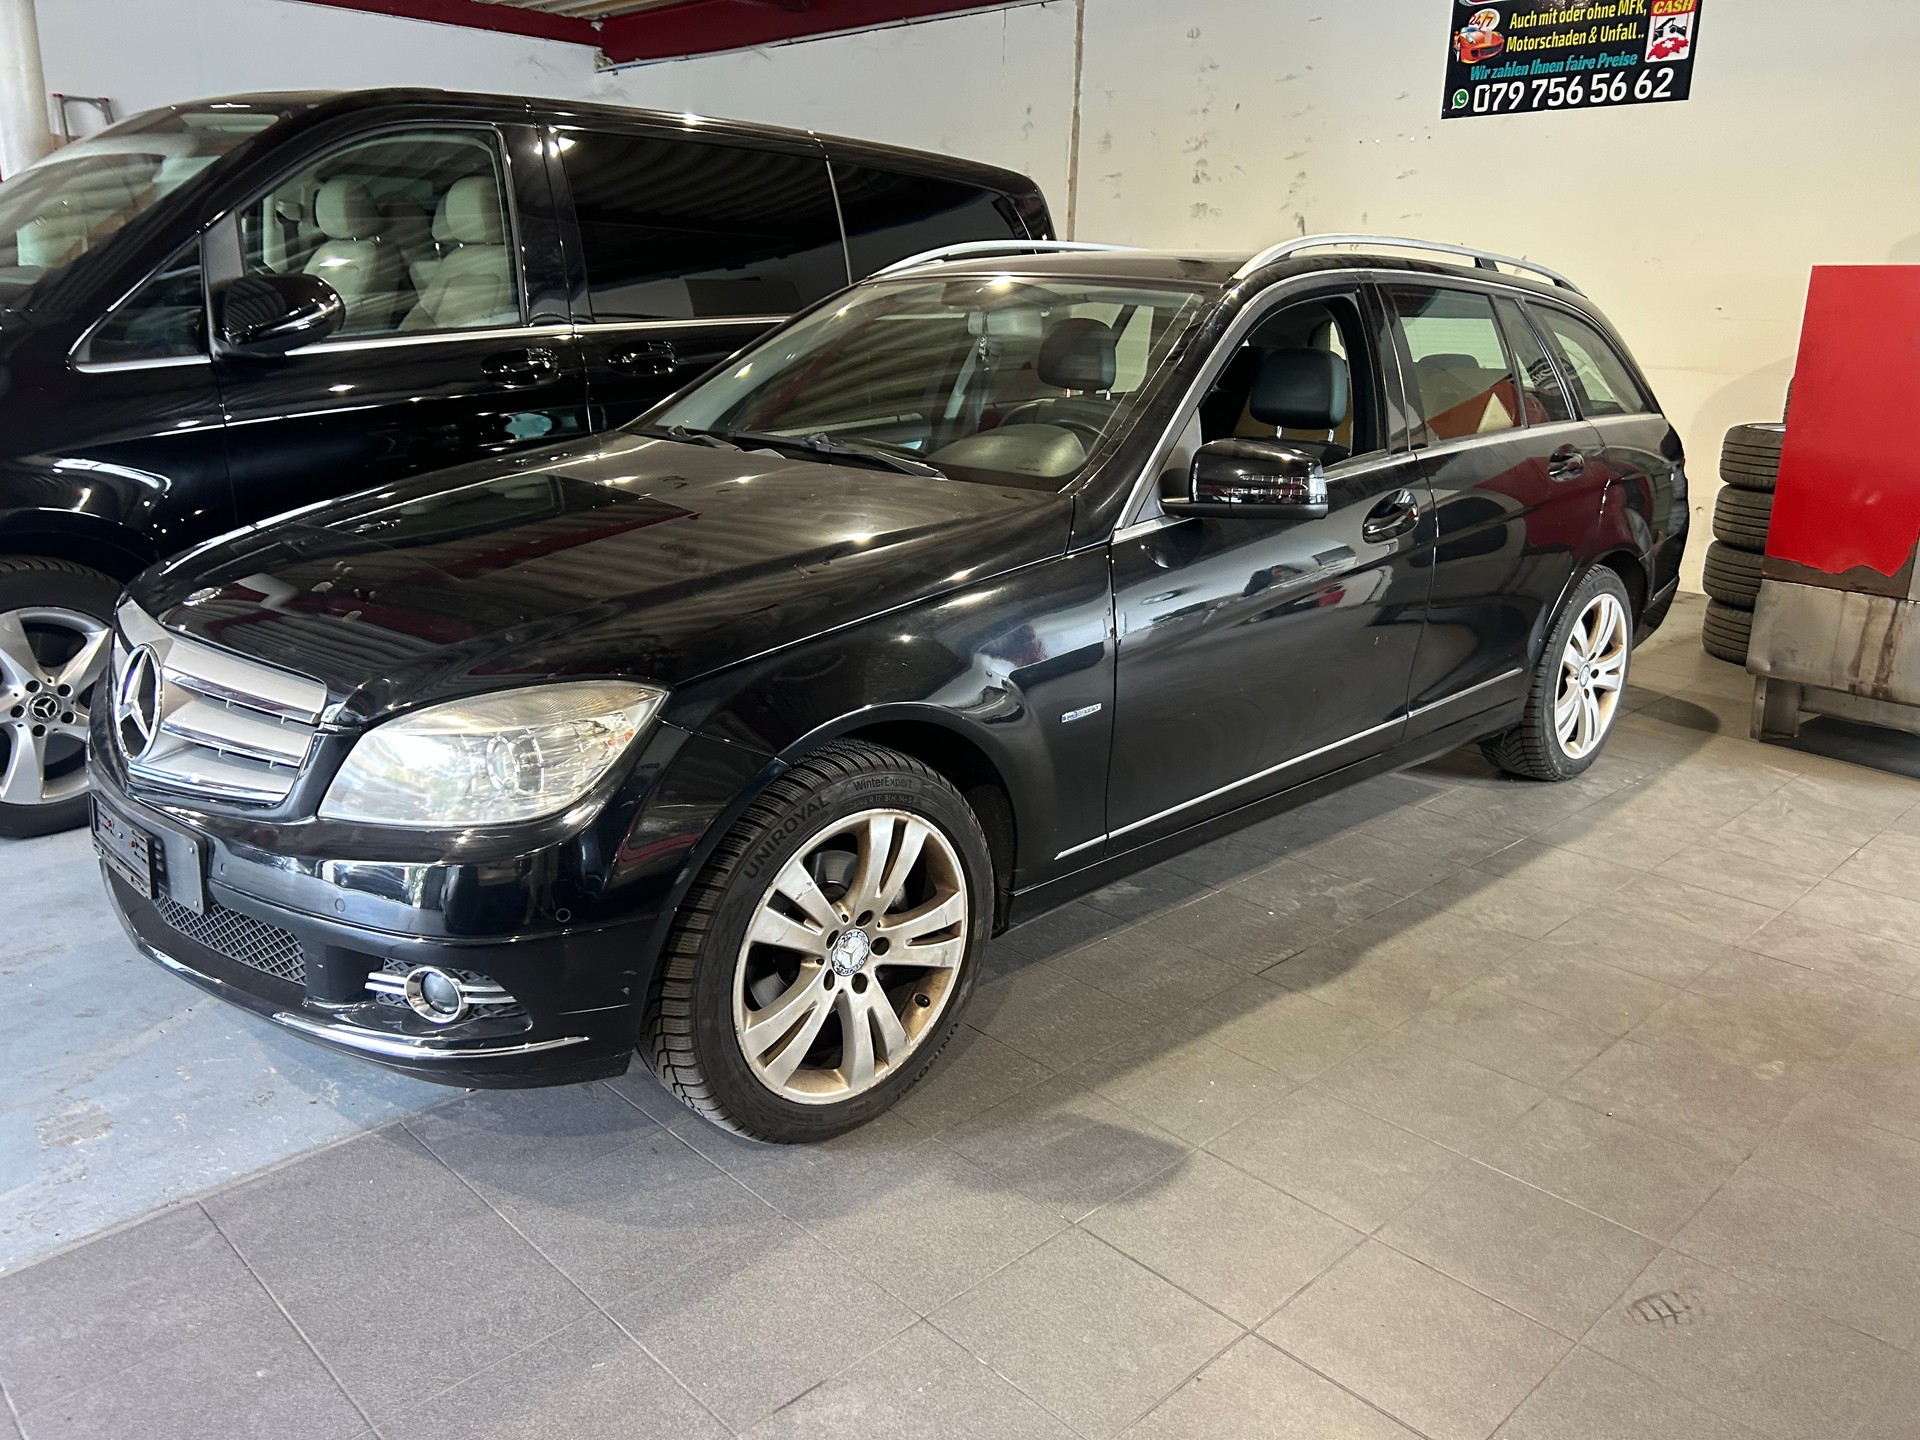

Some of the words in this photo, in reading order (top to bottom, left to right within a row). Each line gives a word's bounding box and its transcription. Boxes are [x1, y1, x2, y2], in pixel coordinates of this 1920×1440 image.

[1509, 10, 1537, 29] Auch
[1538, 7, 1558, 25] mit
[1559, 5, 1585, 23] oder
[1586, 2, 1616, 20] ohne
[1617, 0, 1646, 16] MFK,
[1653, 0, 1693, 14] CASH
[1468, 15, 1493, 29] 24/7
[1506, 28, 1586, 52] Motorschaden
[1587, 26, 1597, 44] &
[1470, 65, 1490, 80] Wir
[1490, 61, 1529, 79] zahlen
[1530, 58, 1563, 74] Ihnen
[1565, 54, 1595, 71] faire
[1597, 50, 1638, 68] Preise
[1473, 81, 1525, 113] 079
[1531, 76, 1584, 108] 756
[1589, 71, 1627, 103] 56
[1634, 67, 1674, 100] 62
[852, 776, 913, 792] WinterExpert
[743, 796, 830, 880] UNIROYAL
